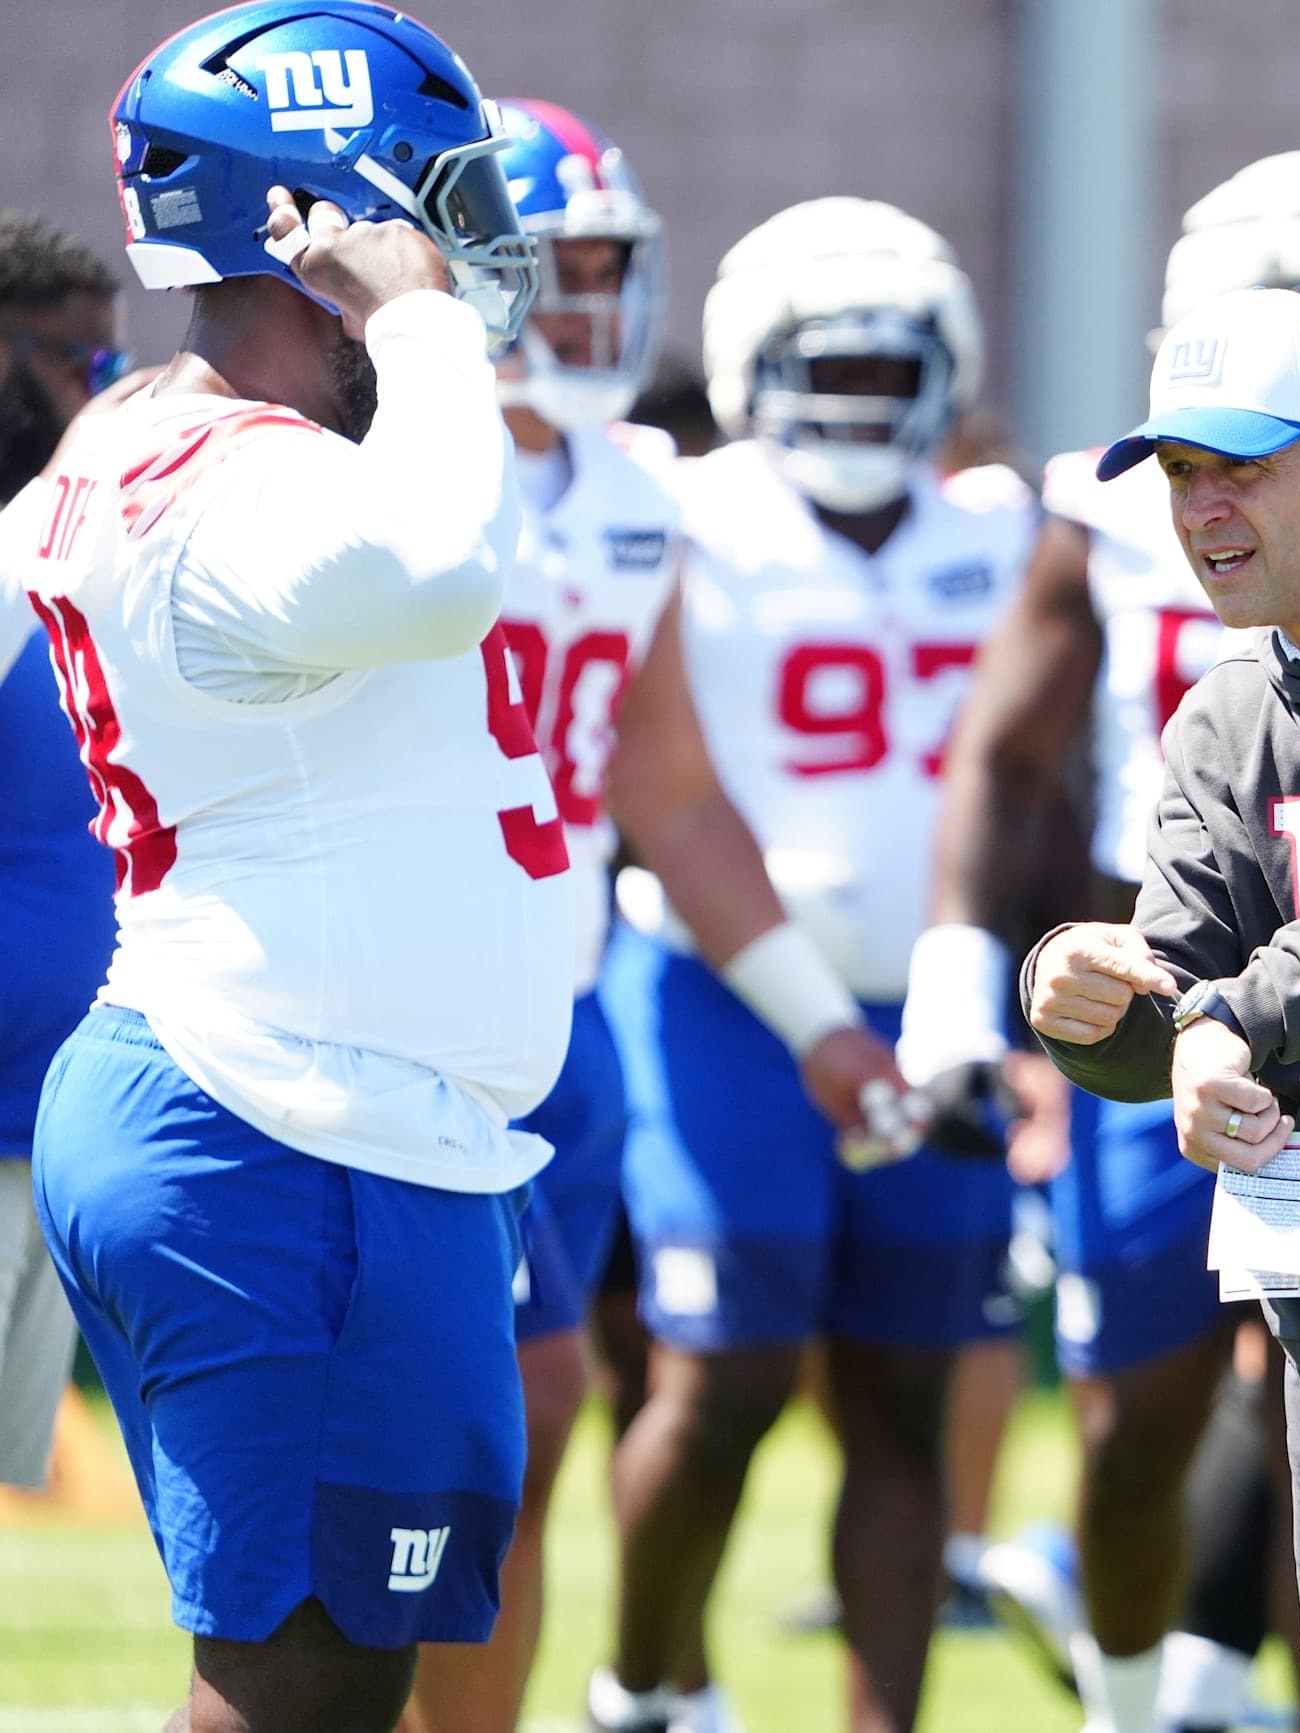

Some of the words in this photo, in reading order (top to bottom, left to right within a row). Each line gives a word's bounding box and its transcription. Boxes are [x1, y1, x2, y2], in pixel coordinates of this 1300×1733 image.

[256, 49, 374, 132] ny
[1168, 338, 1227, 389] ny
[388, 1525, 450, 1592] ny
